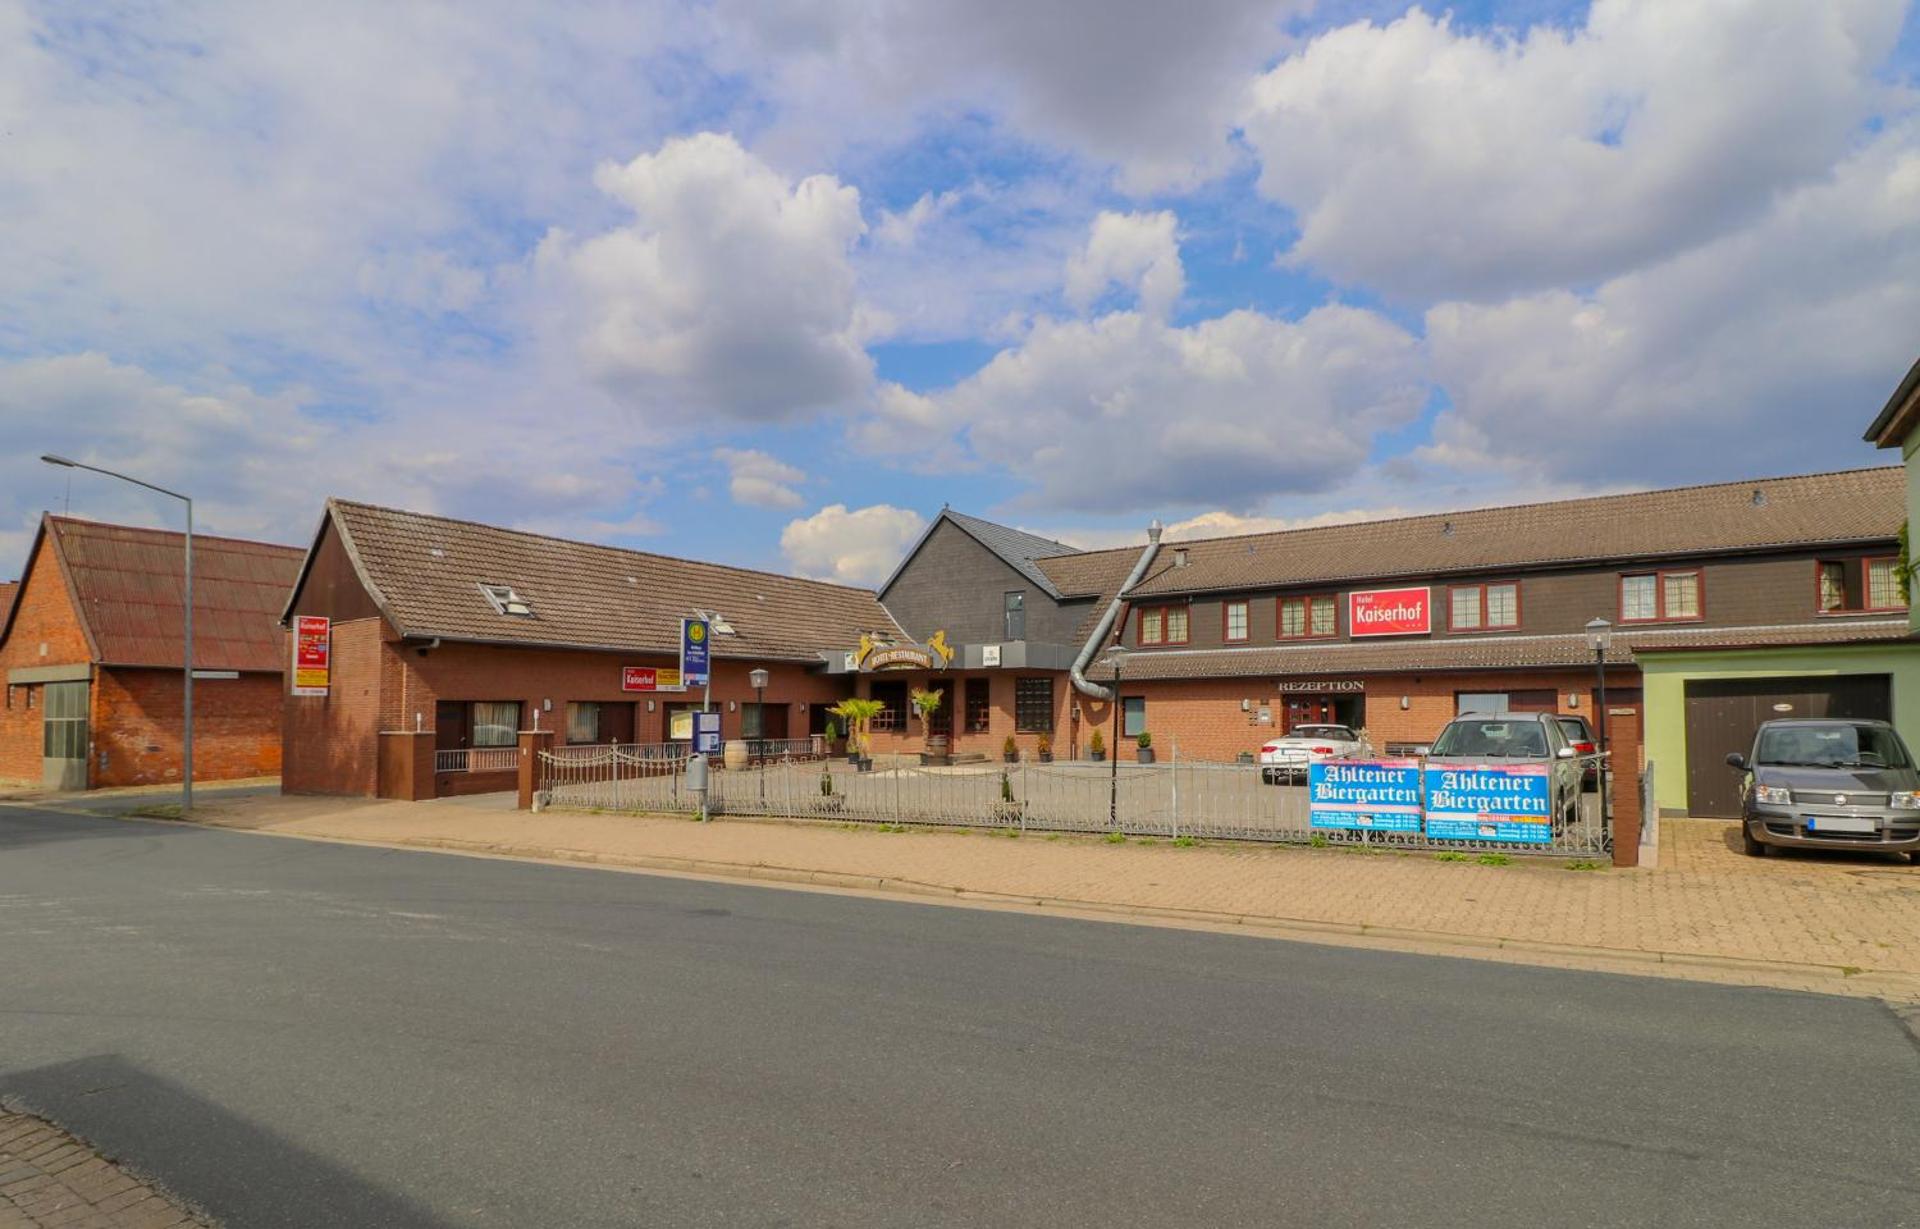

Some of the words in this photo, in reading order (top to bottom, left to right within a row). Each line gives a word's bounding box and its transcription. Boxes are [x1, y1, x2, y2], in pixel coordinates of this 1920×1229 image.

[1356, 602, 1422, 624] Kaiserhof
[1279, 681, 1364, 691] REZEPTION
[1324, 765, 1406, 785] Ahltener
[1440, 771, 1534, 792] Ahltener
[1314, 782, 1417, 804] Biergarten
[1430, 790, 1546, 813] Biergarten
